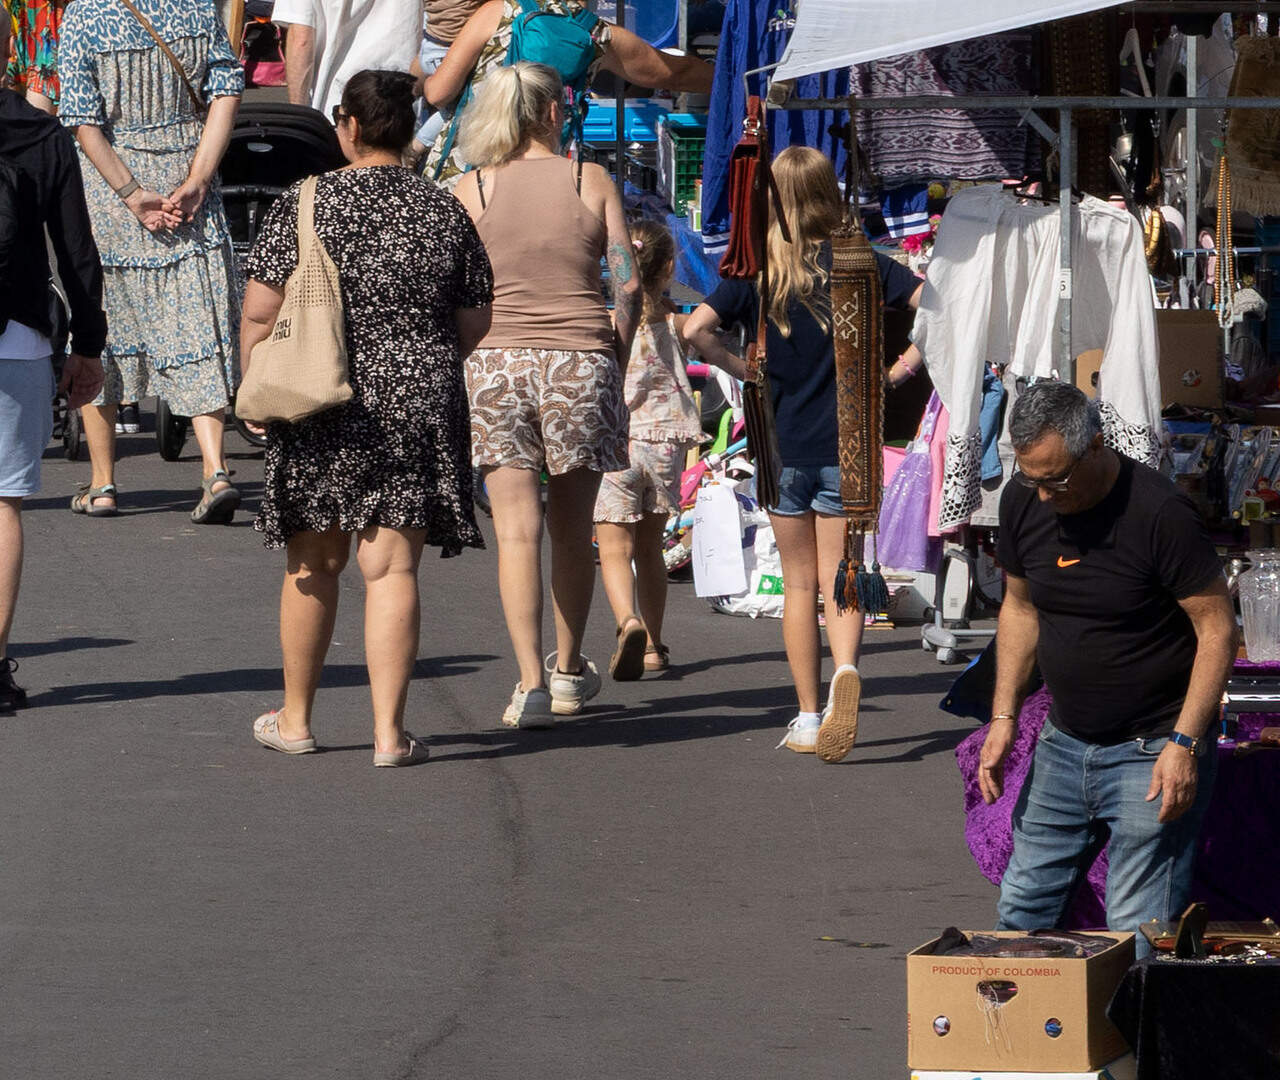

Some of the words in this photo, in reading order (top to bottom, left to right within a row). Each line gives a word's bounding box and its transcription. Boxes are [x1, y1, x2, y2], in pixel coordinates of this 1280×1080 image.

[931, 965, 984, 976] PRODUCT
[986, 967, 1001, 976] OF
[1003, 966, 1062, 978] COLOMBIA
